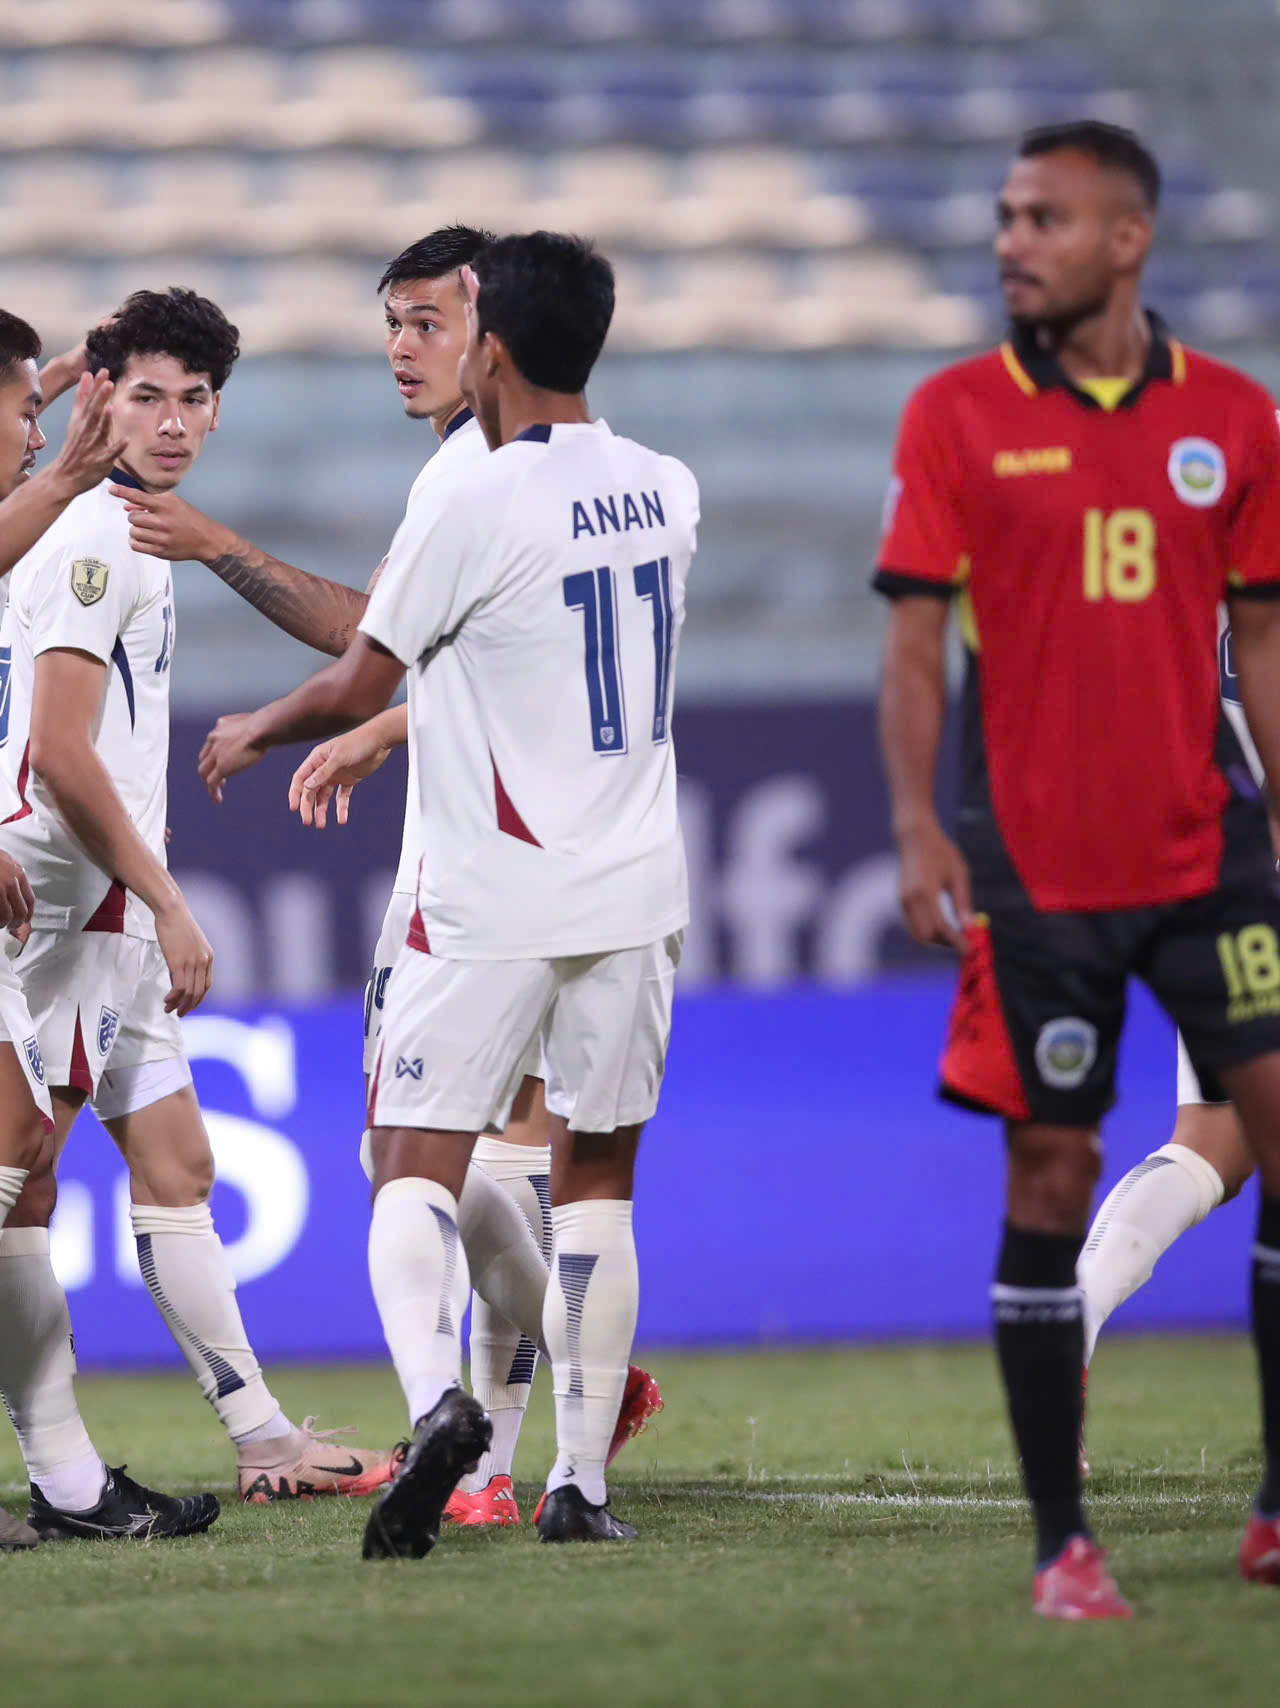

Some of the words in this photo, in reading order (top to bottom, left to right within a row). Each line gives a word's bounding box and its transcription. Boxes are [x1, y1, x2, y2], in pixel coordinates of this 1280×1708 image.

[572, 490, 666, 540] ANAN
[1083, 507, 1157, 603] 18
[563, 555, 674, 757] 11
[1217, 923, 1280, 999] 18
